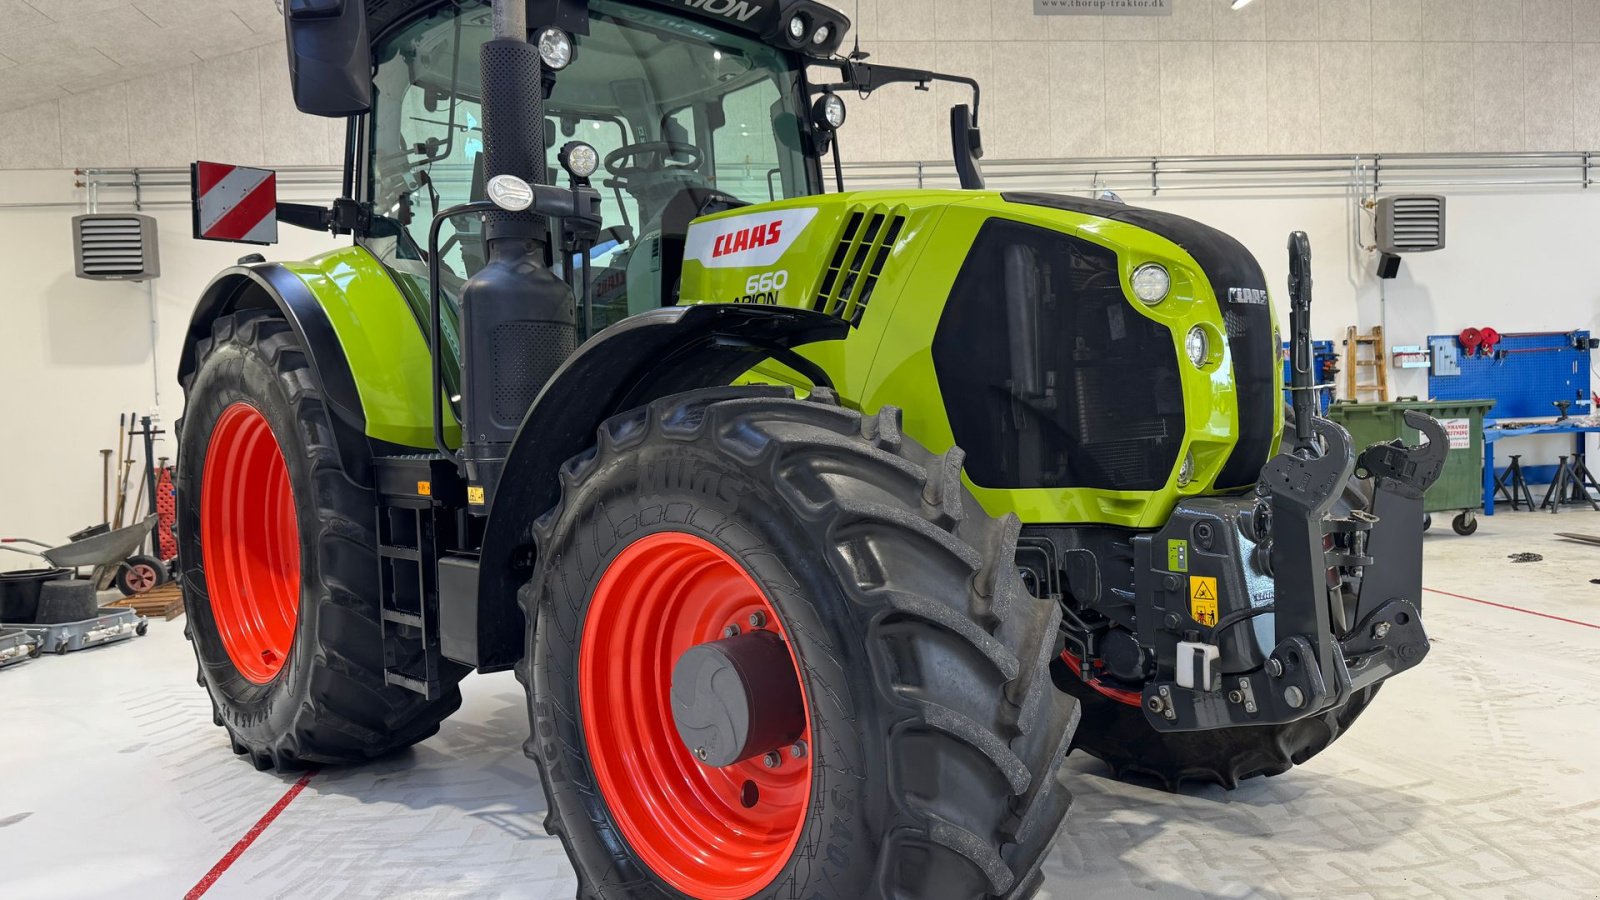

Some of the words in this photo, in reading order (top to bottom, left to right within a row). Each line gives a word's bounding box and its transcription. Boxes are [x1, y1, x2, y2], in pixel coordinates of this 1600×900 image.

[1042, 0, 1165, 9] www.thorup-traktor.dk
[712, 220, 783, 258] CLAAS
[745, 270, 788, 295] 660
[1228, 287, 1267, 306] CLAAS
